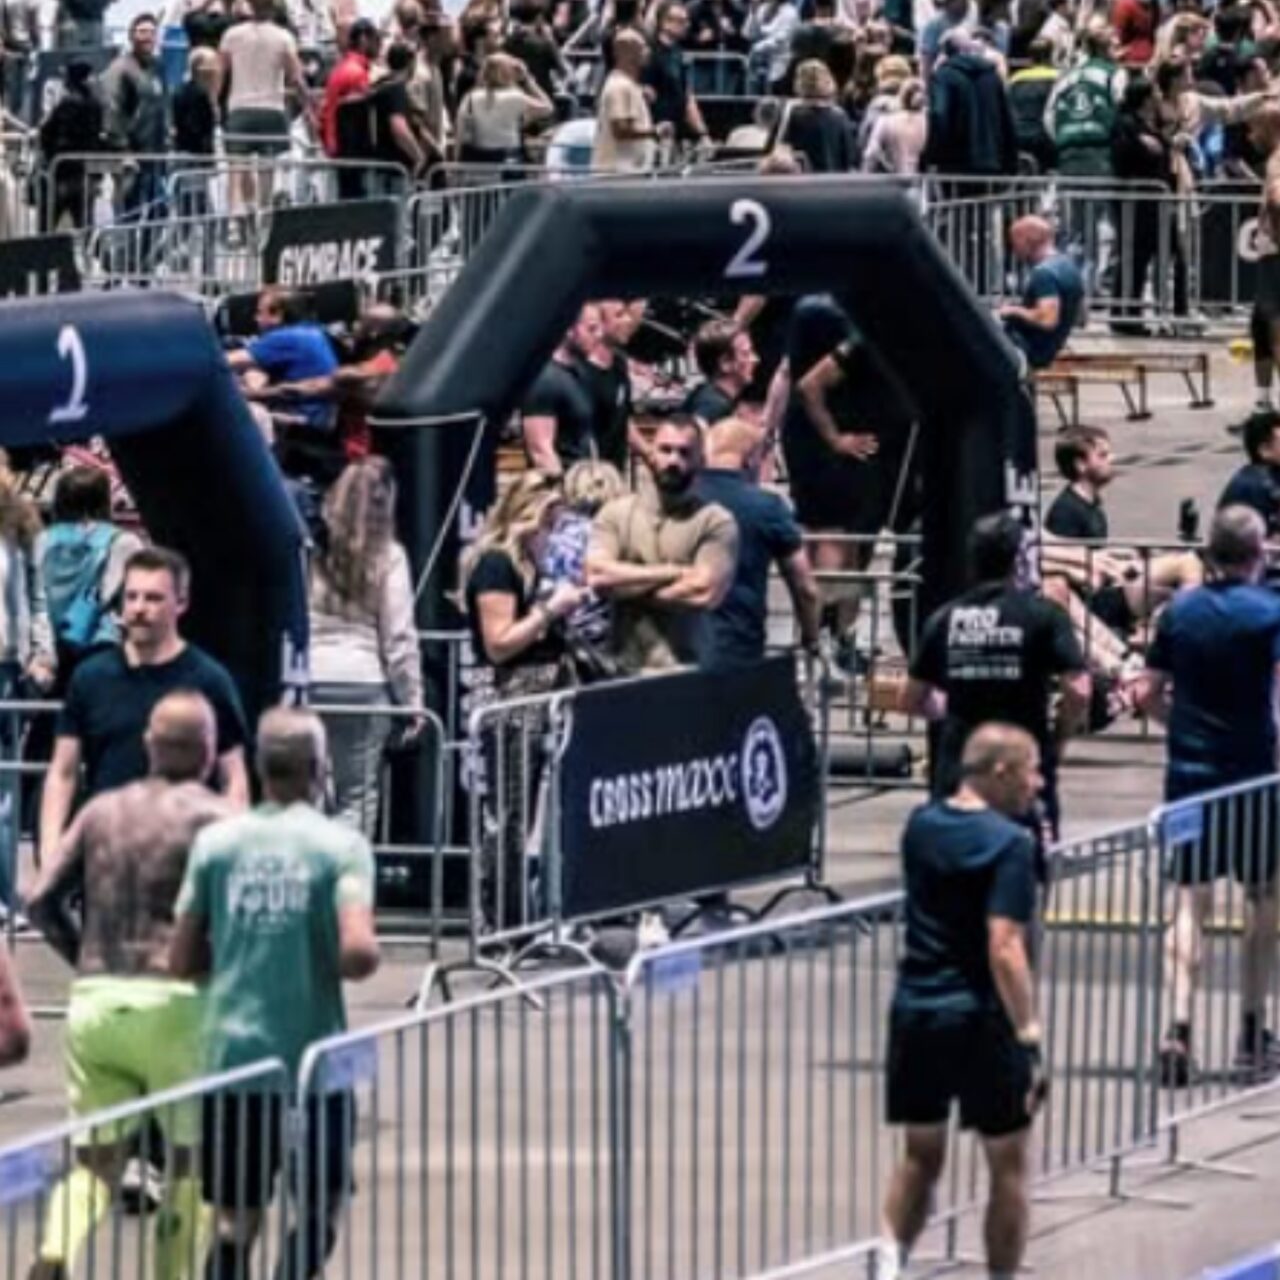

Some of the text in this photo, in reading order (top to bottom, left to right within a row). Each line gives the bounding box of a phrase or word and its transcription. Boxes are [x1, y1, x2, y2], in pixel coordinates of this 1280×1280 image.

[278, 237, 383, 288] GYMRACE
[724, 199, 770, 277] 2
[48, 323, 90, 424] 1
